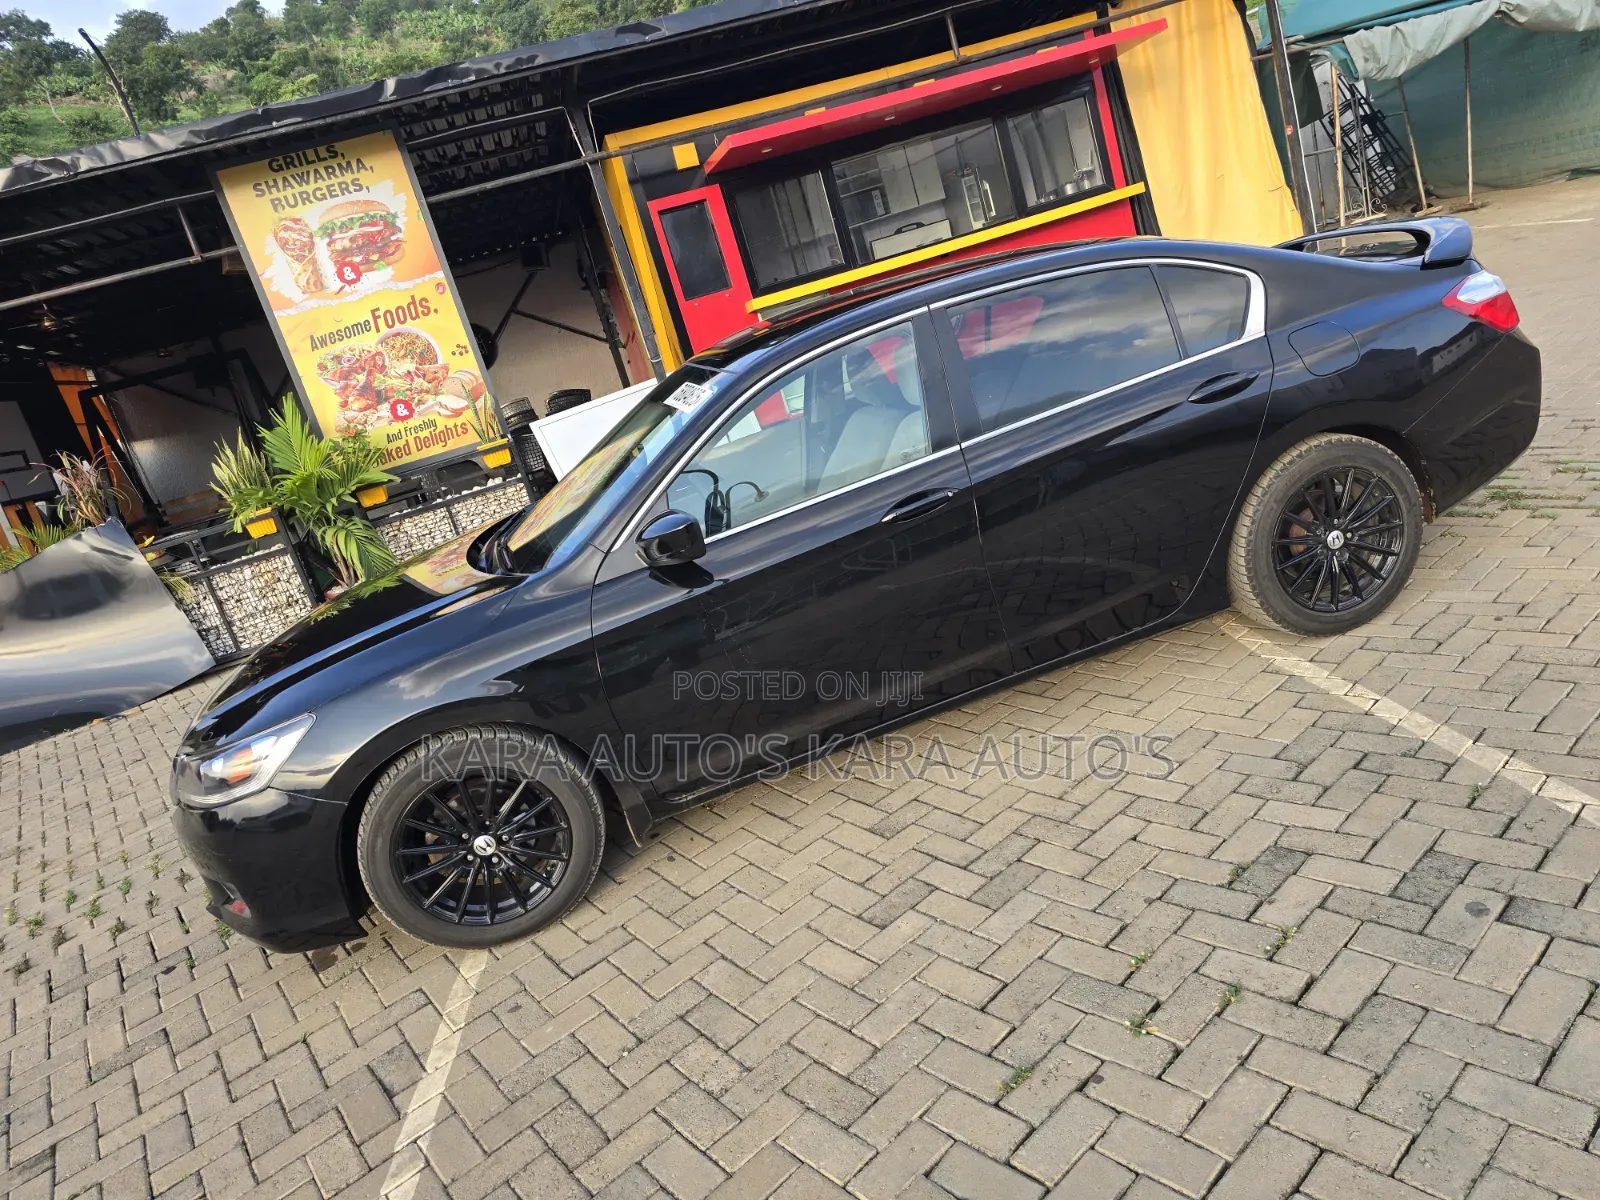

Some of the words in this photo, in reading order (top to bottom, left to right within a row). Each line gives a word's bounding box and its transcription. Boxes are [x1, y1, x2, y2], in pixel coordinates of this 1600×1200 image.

[268, 144, 345, 173] GRILLS,
[252, 157, 374, 198] SHAWARMA,
[269, 178, 371, 213] BURGERS,
[342, 266, 357, 280] &
[309, 319, 372, 352] Awesome
[396, 403, 409, 417] &
[372, 439, 412, 469] aked
[413, 421, 469, 452] Delights
[386, 428, 403, 445] And
[404, 417, 438, 438] Freshly
